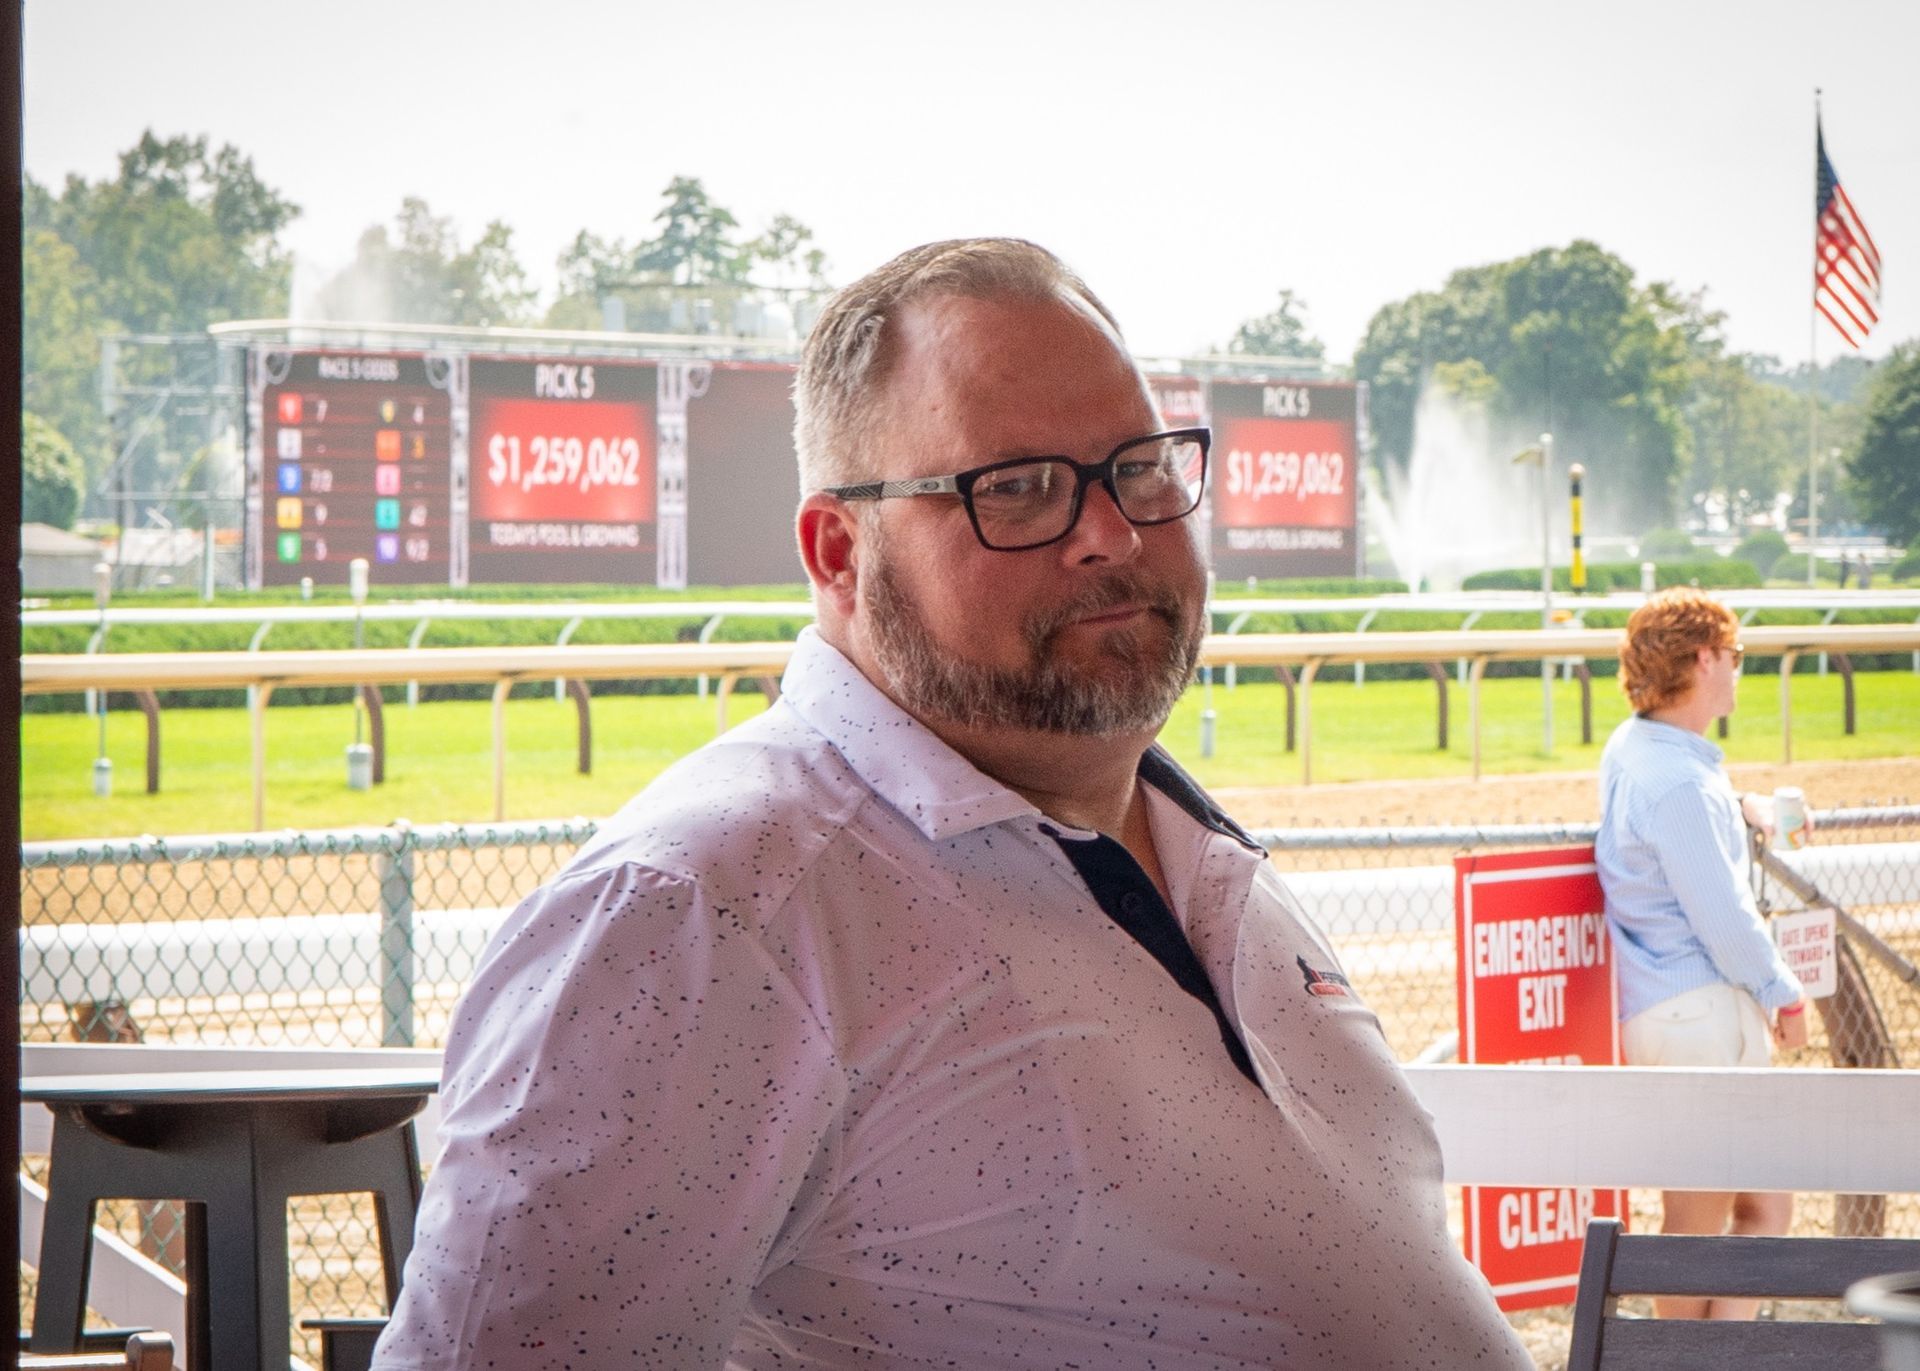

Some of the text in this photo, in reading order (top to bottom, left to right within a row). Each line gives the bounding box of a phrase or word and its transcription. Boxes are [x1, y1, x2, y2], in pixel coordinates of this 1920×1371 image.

[535, 363, 595, 399] PICK 5
[1263, 386, 1310, 417] PICK 5
[488, 433, 640, 494] $1,259,062
[1227, 449, 1344, 502] $1,259,062
[1474, 913, 1607, 978] EMERGENCY
[1518, 974, 1568, 1032] EXIT
[1498, 1188, 1594, 1250] CLEAR
